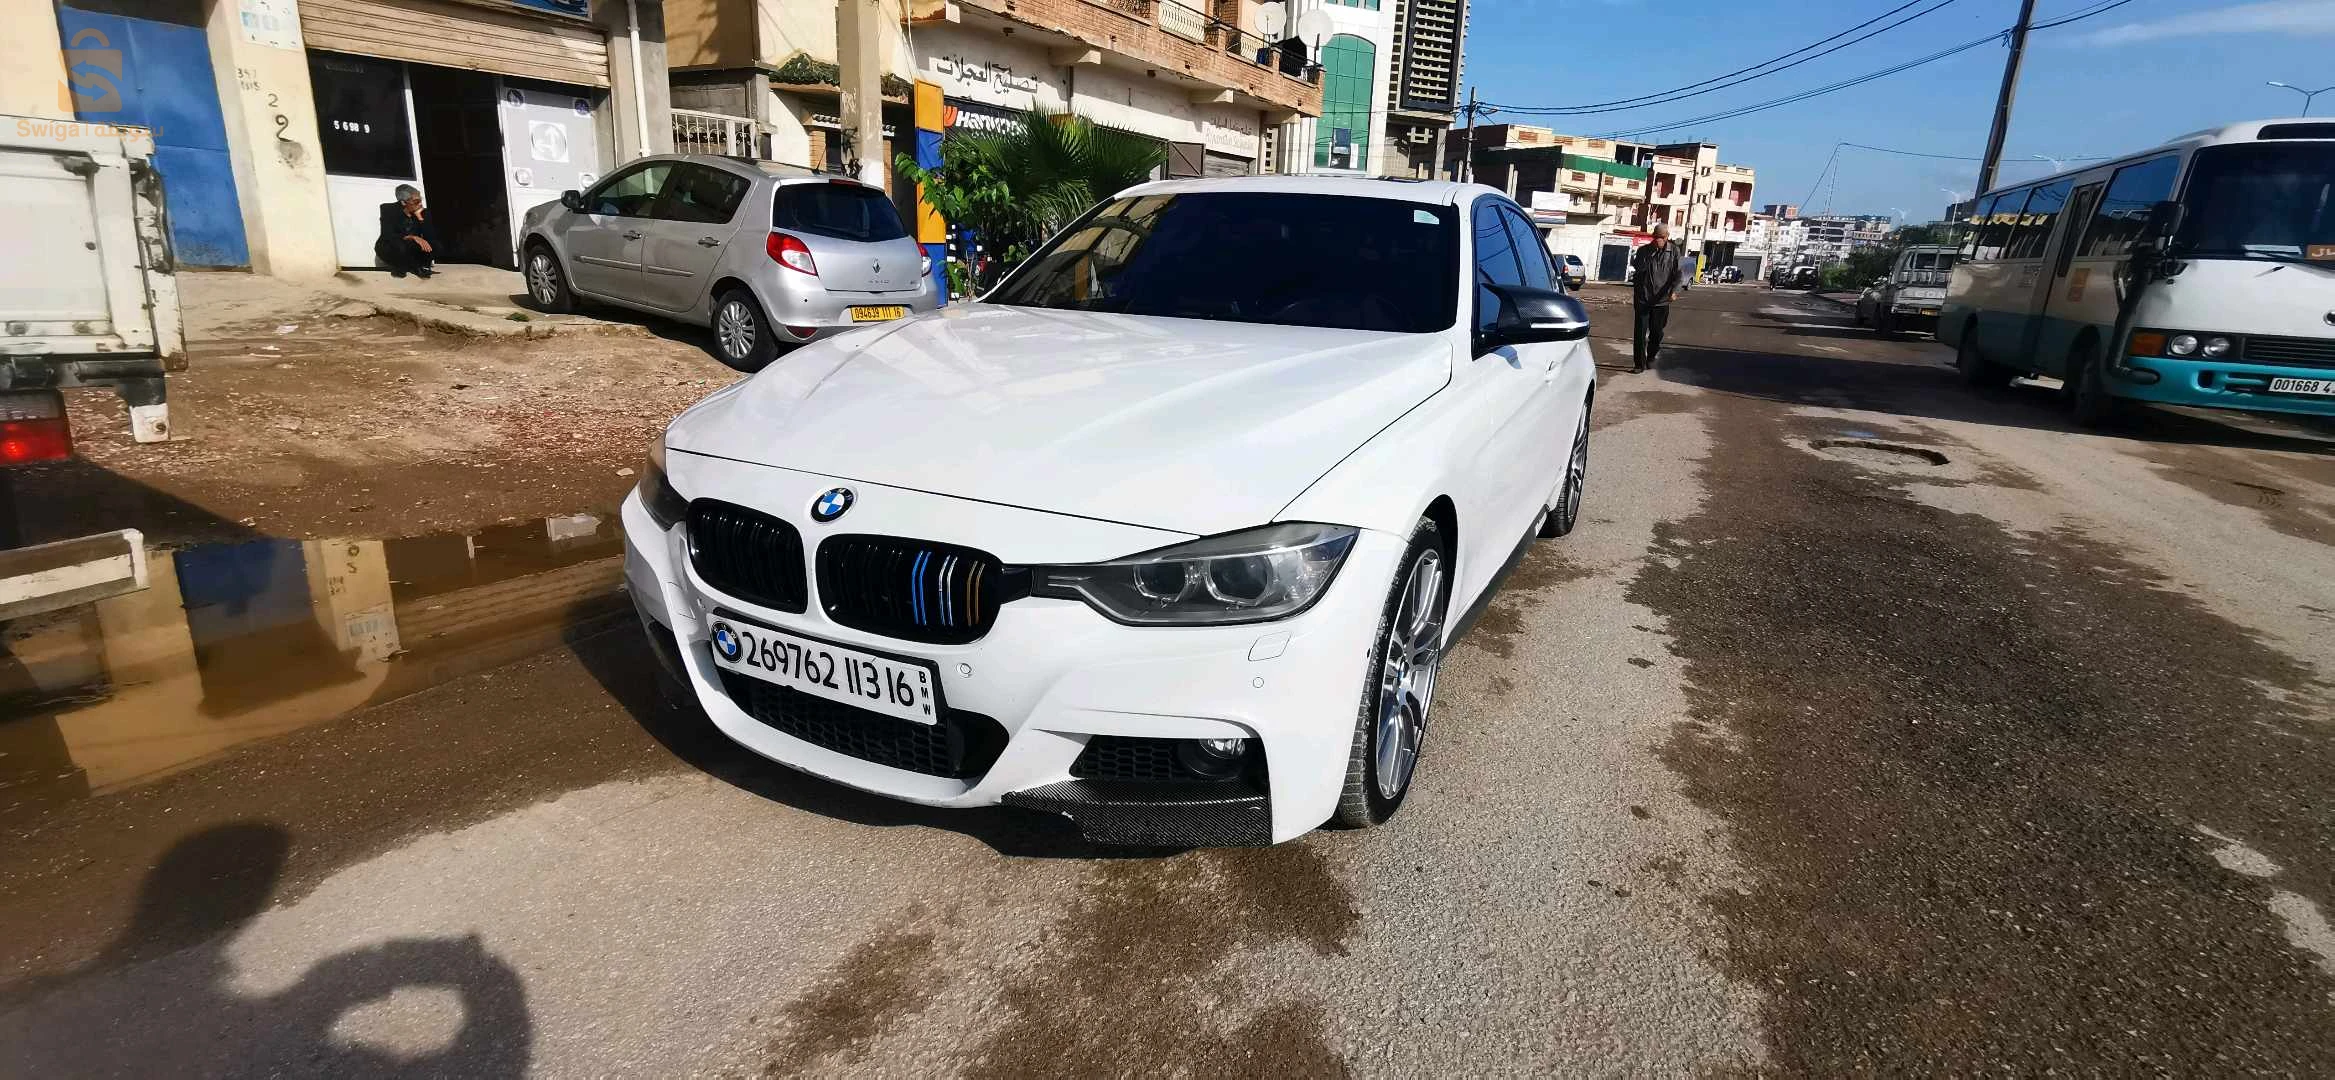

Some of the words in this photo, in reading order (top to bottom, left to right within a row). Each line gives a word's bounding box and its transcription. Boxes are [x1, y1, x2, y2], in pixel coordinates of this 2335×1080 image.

[936, 54, 992, 88] العجلات
[992, 62, 1038, 94] تصليح
[2274, 379, 2319, 392] 001668
[742, 631, 839, 690] 269762
[844, 656, 881, 700] 113
[885, 667, 914, 707] 16
